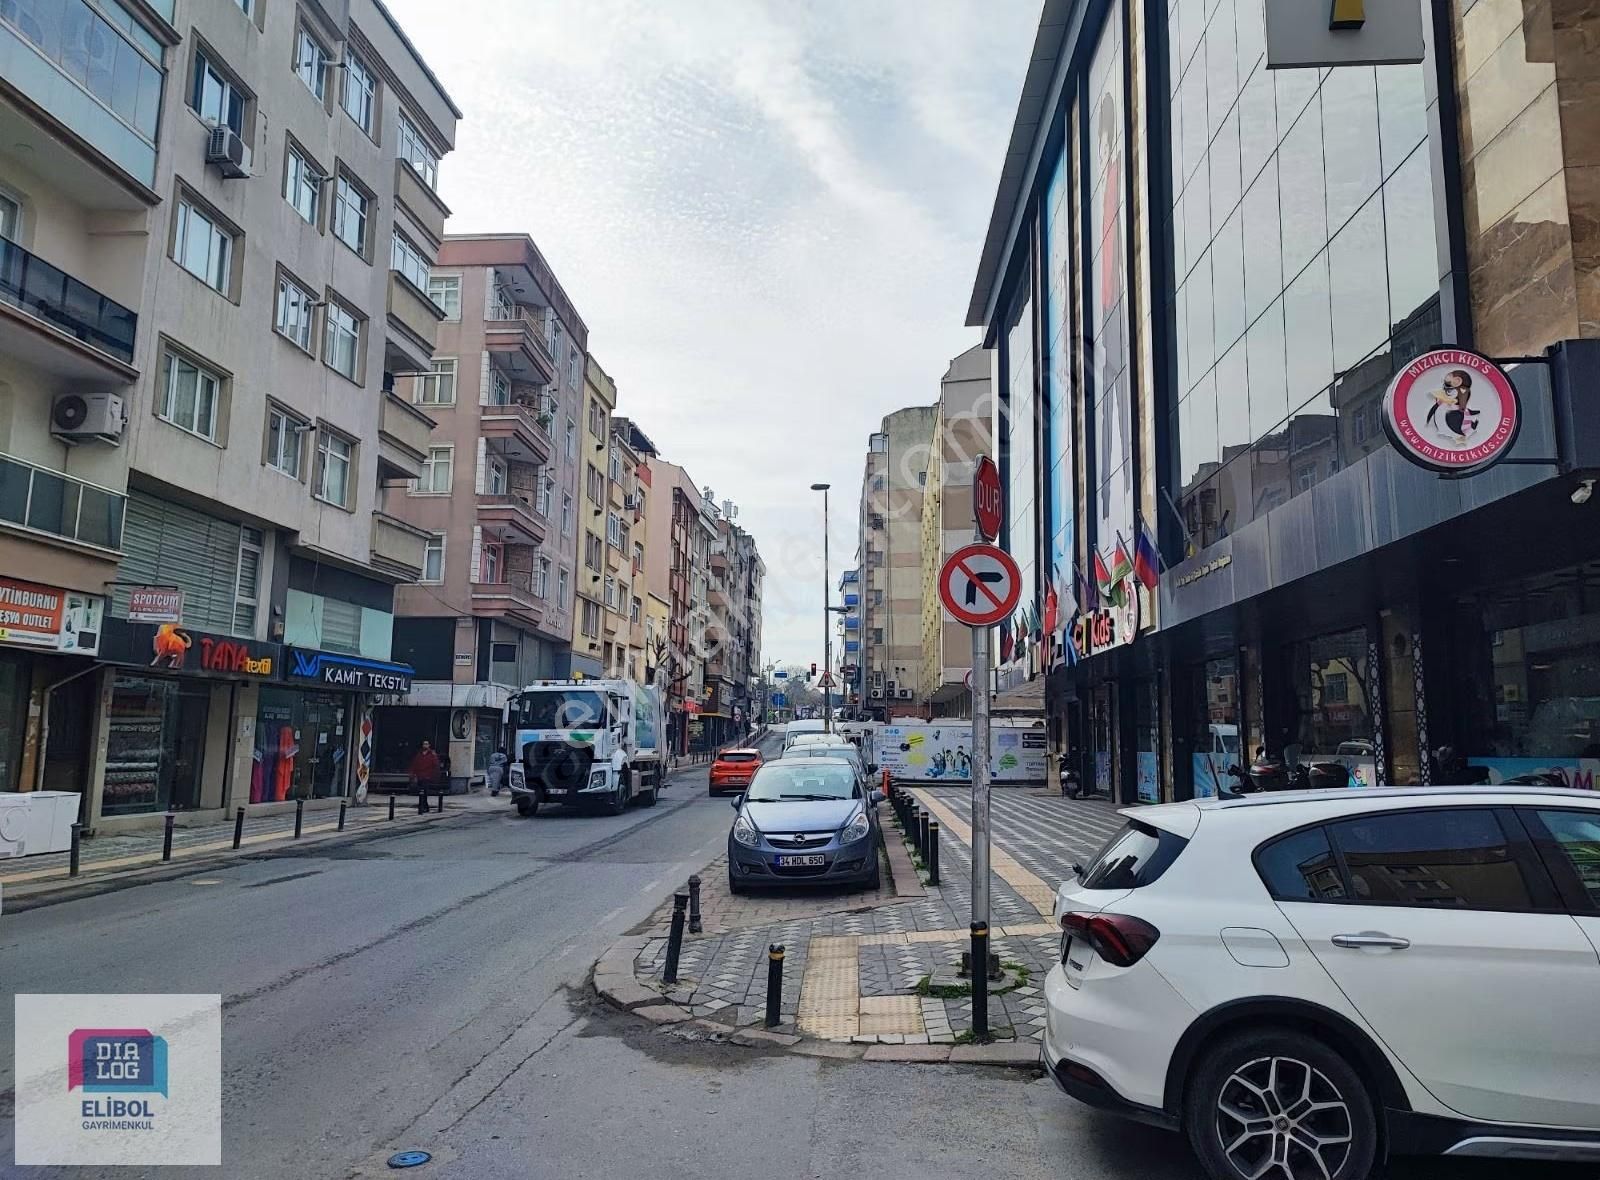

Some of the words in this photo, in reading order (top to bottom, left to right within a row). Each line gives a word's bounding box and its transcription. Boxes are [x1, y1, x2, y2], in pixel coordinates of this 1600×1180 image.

[978, 480, 1000, 515] DUR
[23, 613, 53, 629] OUTLET
[325, 667, 363, 686] KAMİT
[368, 673, 408, 691] TEKSTİL
[780, 856, 790, 866] 34
[792, 856, 806, 865] HDL
[808, 855, 823, 865] 650
